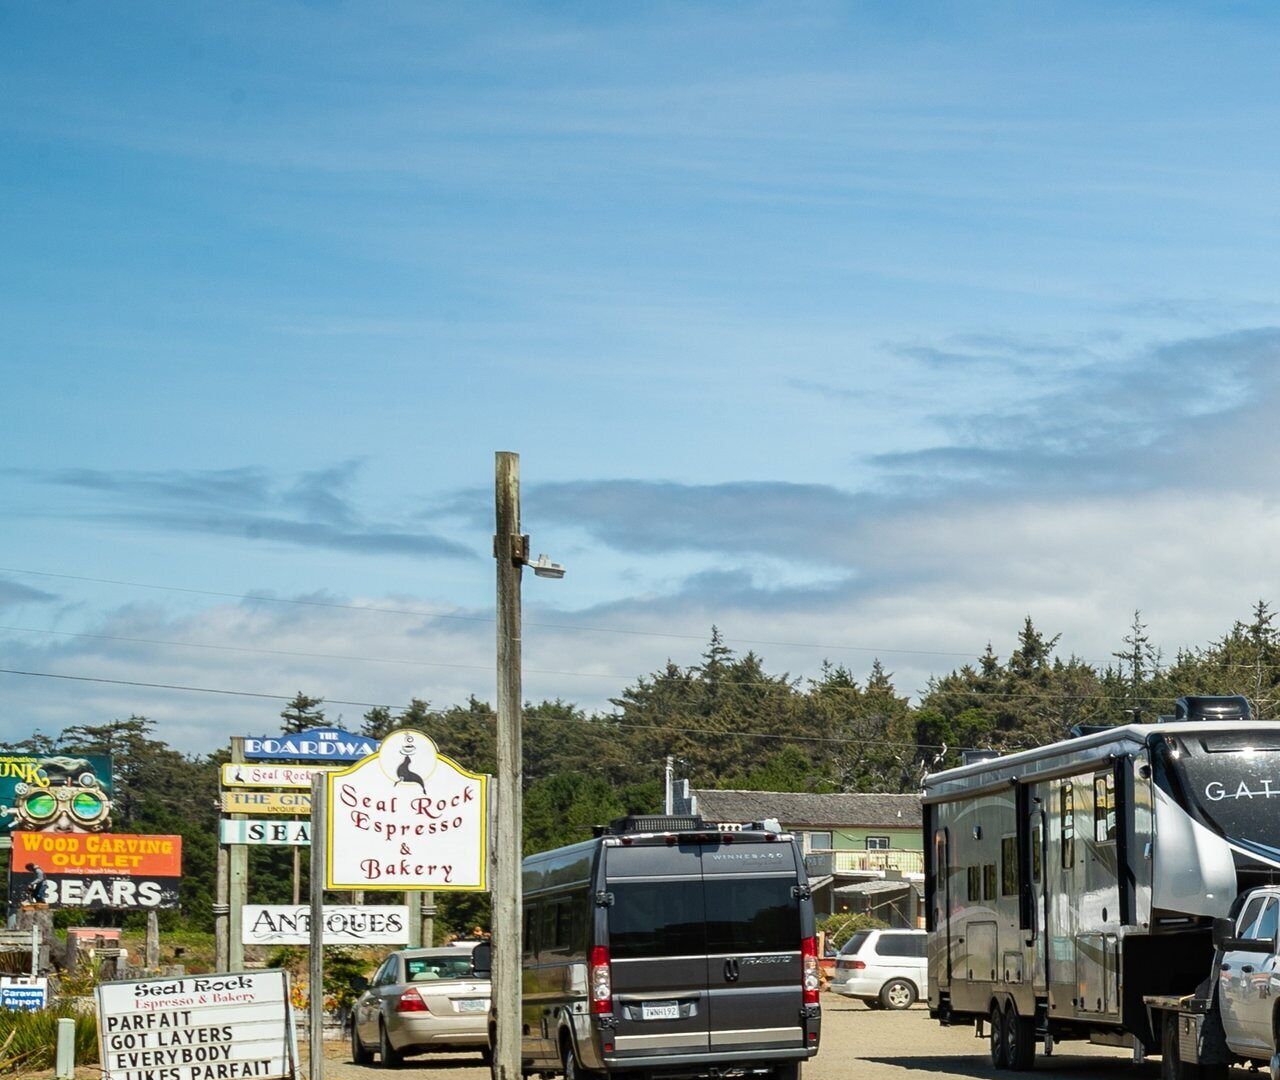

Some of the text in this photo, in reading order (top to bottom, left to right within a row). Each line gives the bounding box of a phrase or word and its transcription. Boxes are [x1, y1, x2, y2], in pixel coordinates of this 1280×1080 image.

[318, 732, 339, 740] THE
[244, 739, 381, 755] BOARDWA
[252, 769, 278, 782] Seal
[232, 794, 271, 804] THE
[340, 784, 474, 820] Seal Rock
[351, 810, 463, 841] Espresso
[21, 833, 174, 854] WOOD CARVING
[400, 842, 412, 856] &
[52, 853, 144, 868] OUTLET
[360, 858, 453, 883] Bakery
[250, 910, 404, 938] ANTQUES
[2, 989, 43, 997] Caravan
[134, 976, 253, 997] Seal Rock
[5, 998, 41, 1006] Airport
[135, 991, 256, 1011] Espresso & Bakery
[107, 1011, 192, 1032] PARFAIT
[111, 1026, 233, 1050] GOT LAYERS
[117, 1044, 232, 1069] EVERYBODY
